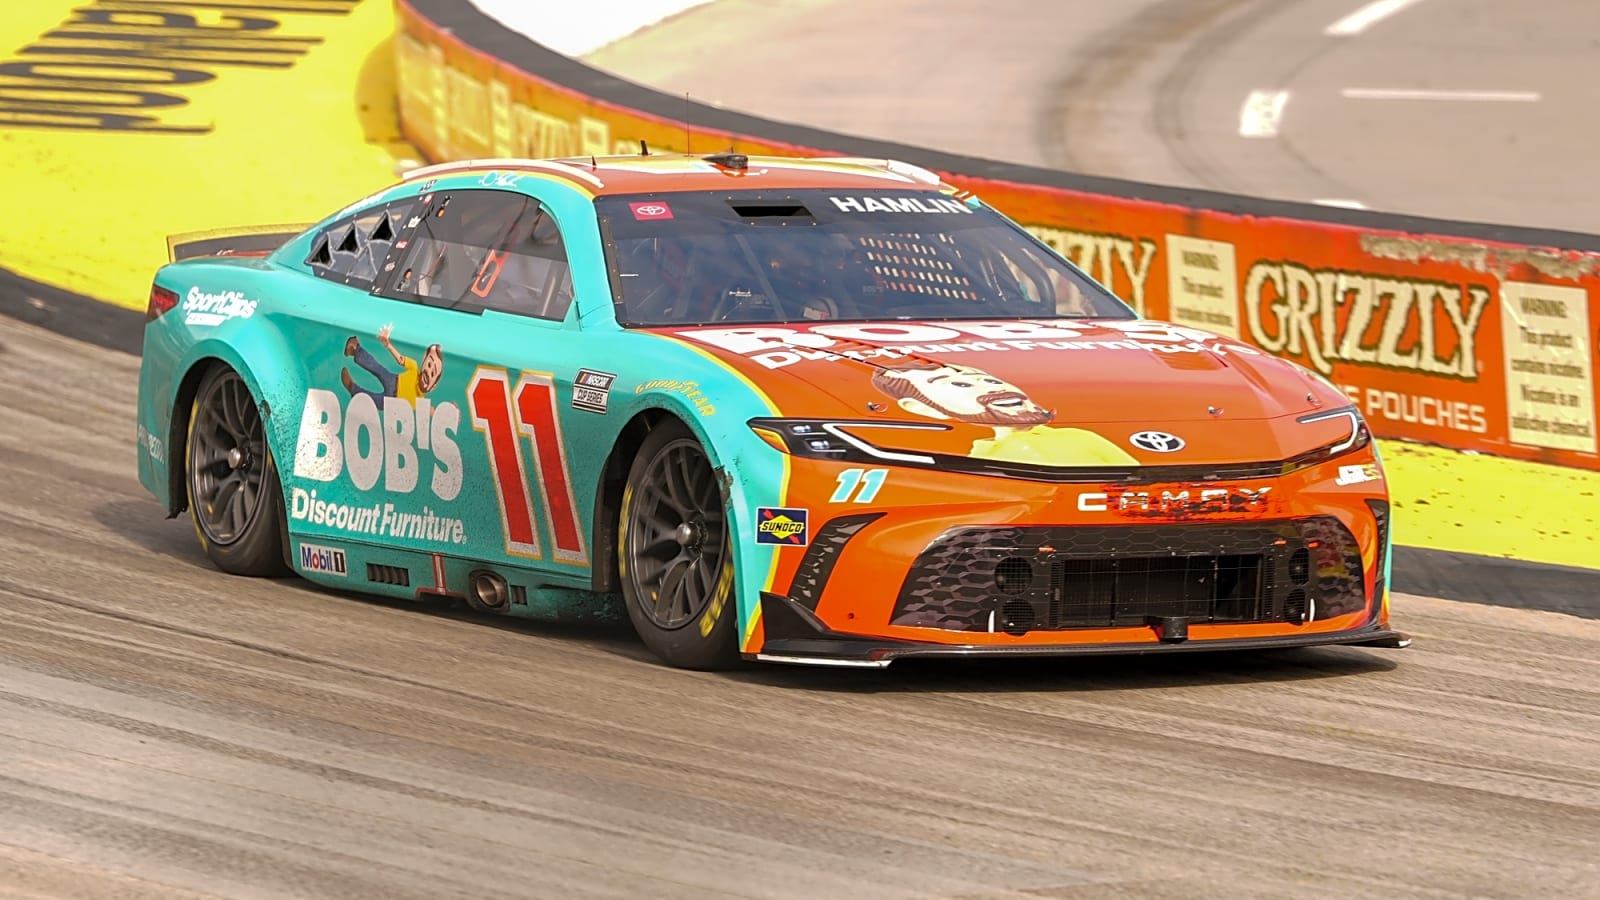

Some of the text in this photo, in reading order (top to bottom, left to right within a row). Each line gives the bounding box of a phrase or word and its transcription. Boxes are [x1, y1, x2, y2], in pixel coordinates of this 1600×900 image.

[829, 197, 973, 214] HAMLIN
[1245, 260, 1490, 382] GRIZZLY
[1366, 387, 1488, 433] POUCHES
[293, 388, 463, 501] BOB'S
[465, 364, 590, 567] 11
[828, 468, 889, 504] 11
[291, 487, 381, 535] Discount
[761, 521, 803, 534] SUNOCO
[301, 545, 345, 573] Mobil 1
